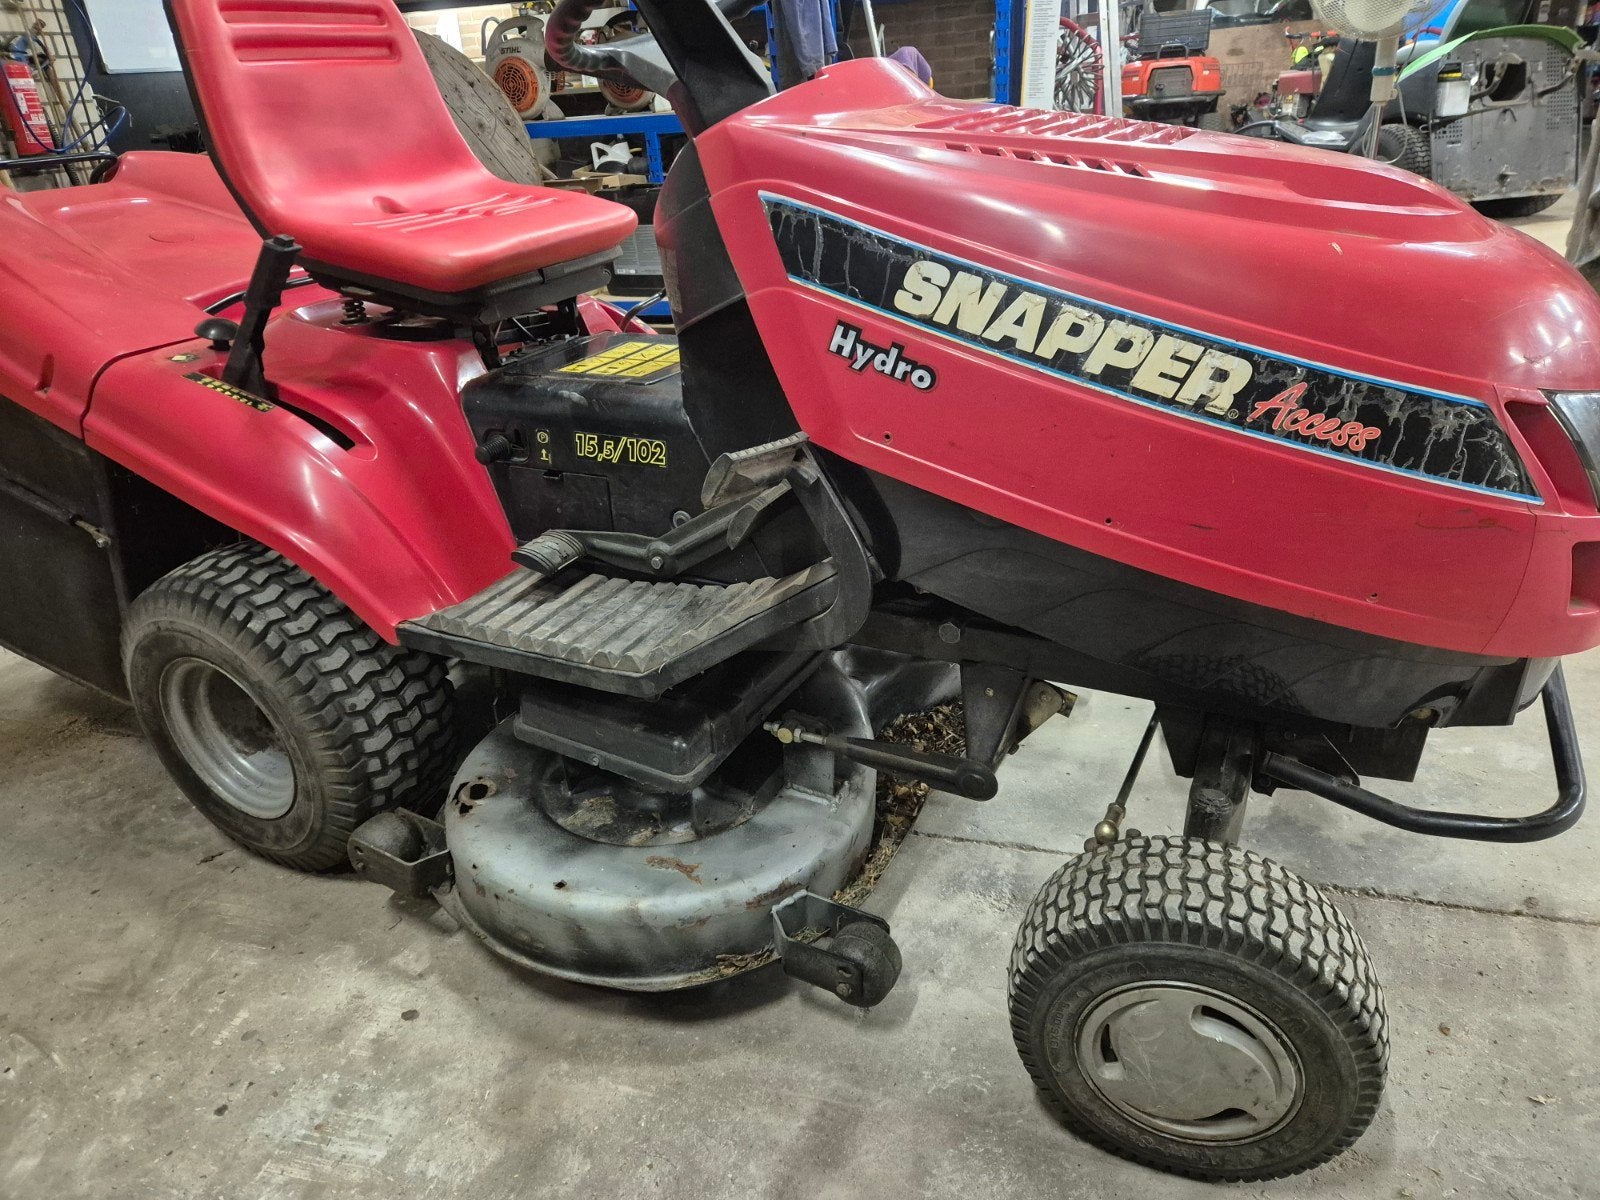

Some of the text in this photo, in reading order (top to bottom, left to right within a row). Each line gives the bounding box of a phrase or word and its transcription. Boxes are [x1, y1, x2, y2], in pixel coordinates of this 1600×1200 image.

[500, 46, 522, 55] STIHL
[828, 321, 935, 390] Hydro
[893, 260, 1382, 451] SNAPPER Access
[575, 433, 667, 466] 15,5/102
